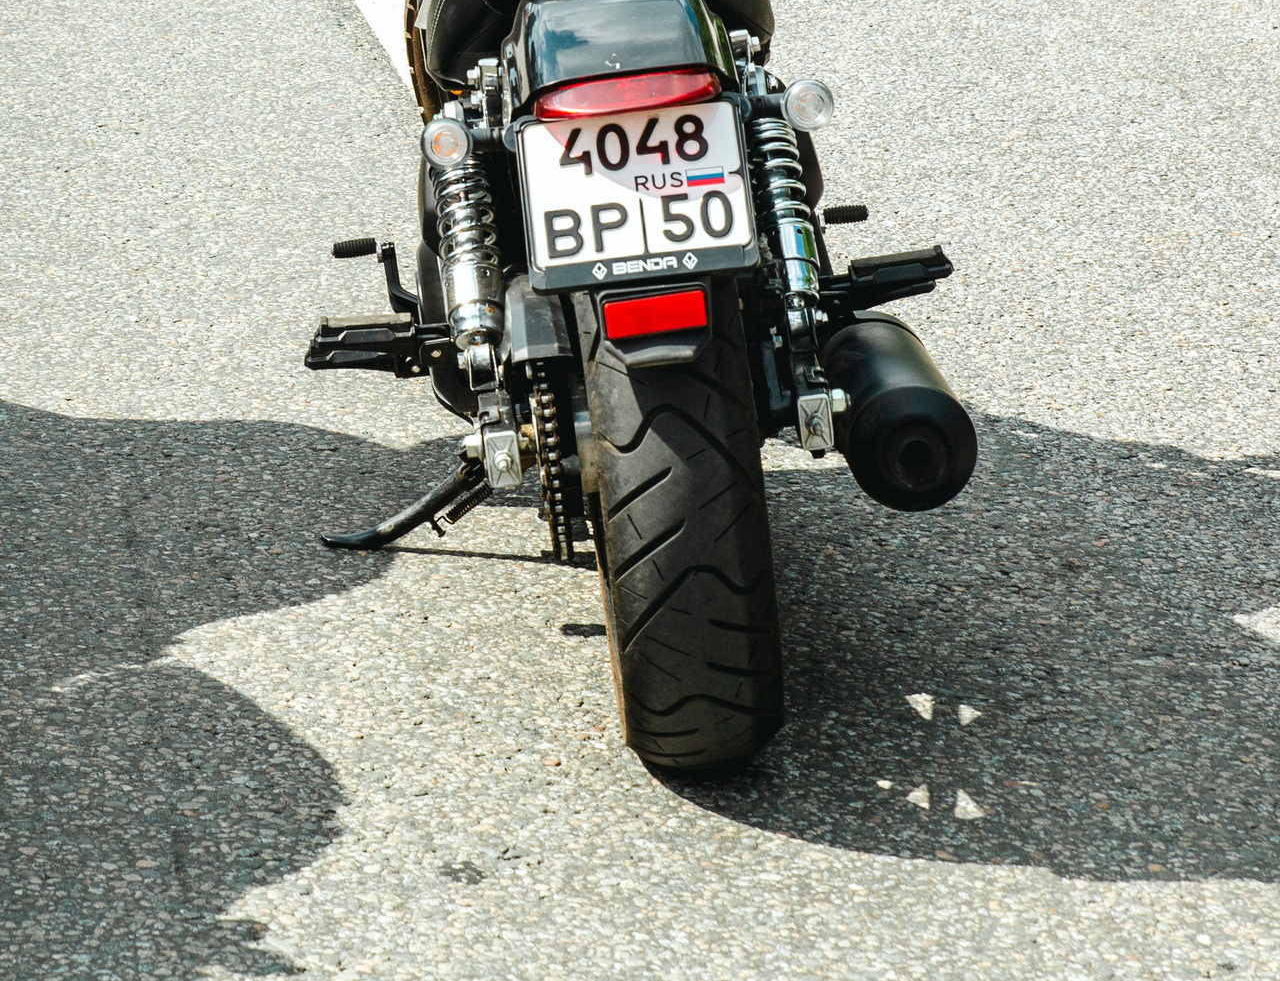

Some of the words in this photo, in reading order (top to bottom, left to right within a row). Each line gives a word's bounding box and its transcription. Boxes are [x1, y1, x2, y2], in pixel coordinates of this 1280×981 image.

[559, 114, 709, 176] 4048
[634, 171, 684, 192] RUS
[660, 190, 734, 242] 50
[612, 256, 678, 276] BENDA
